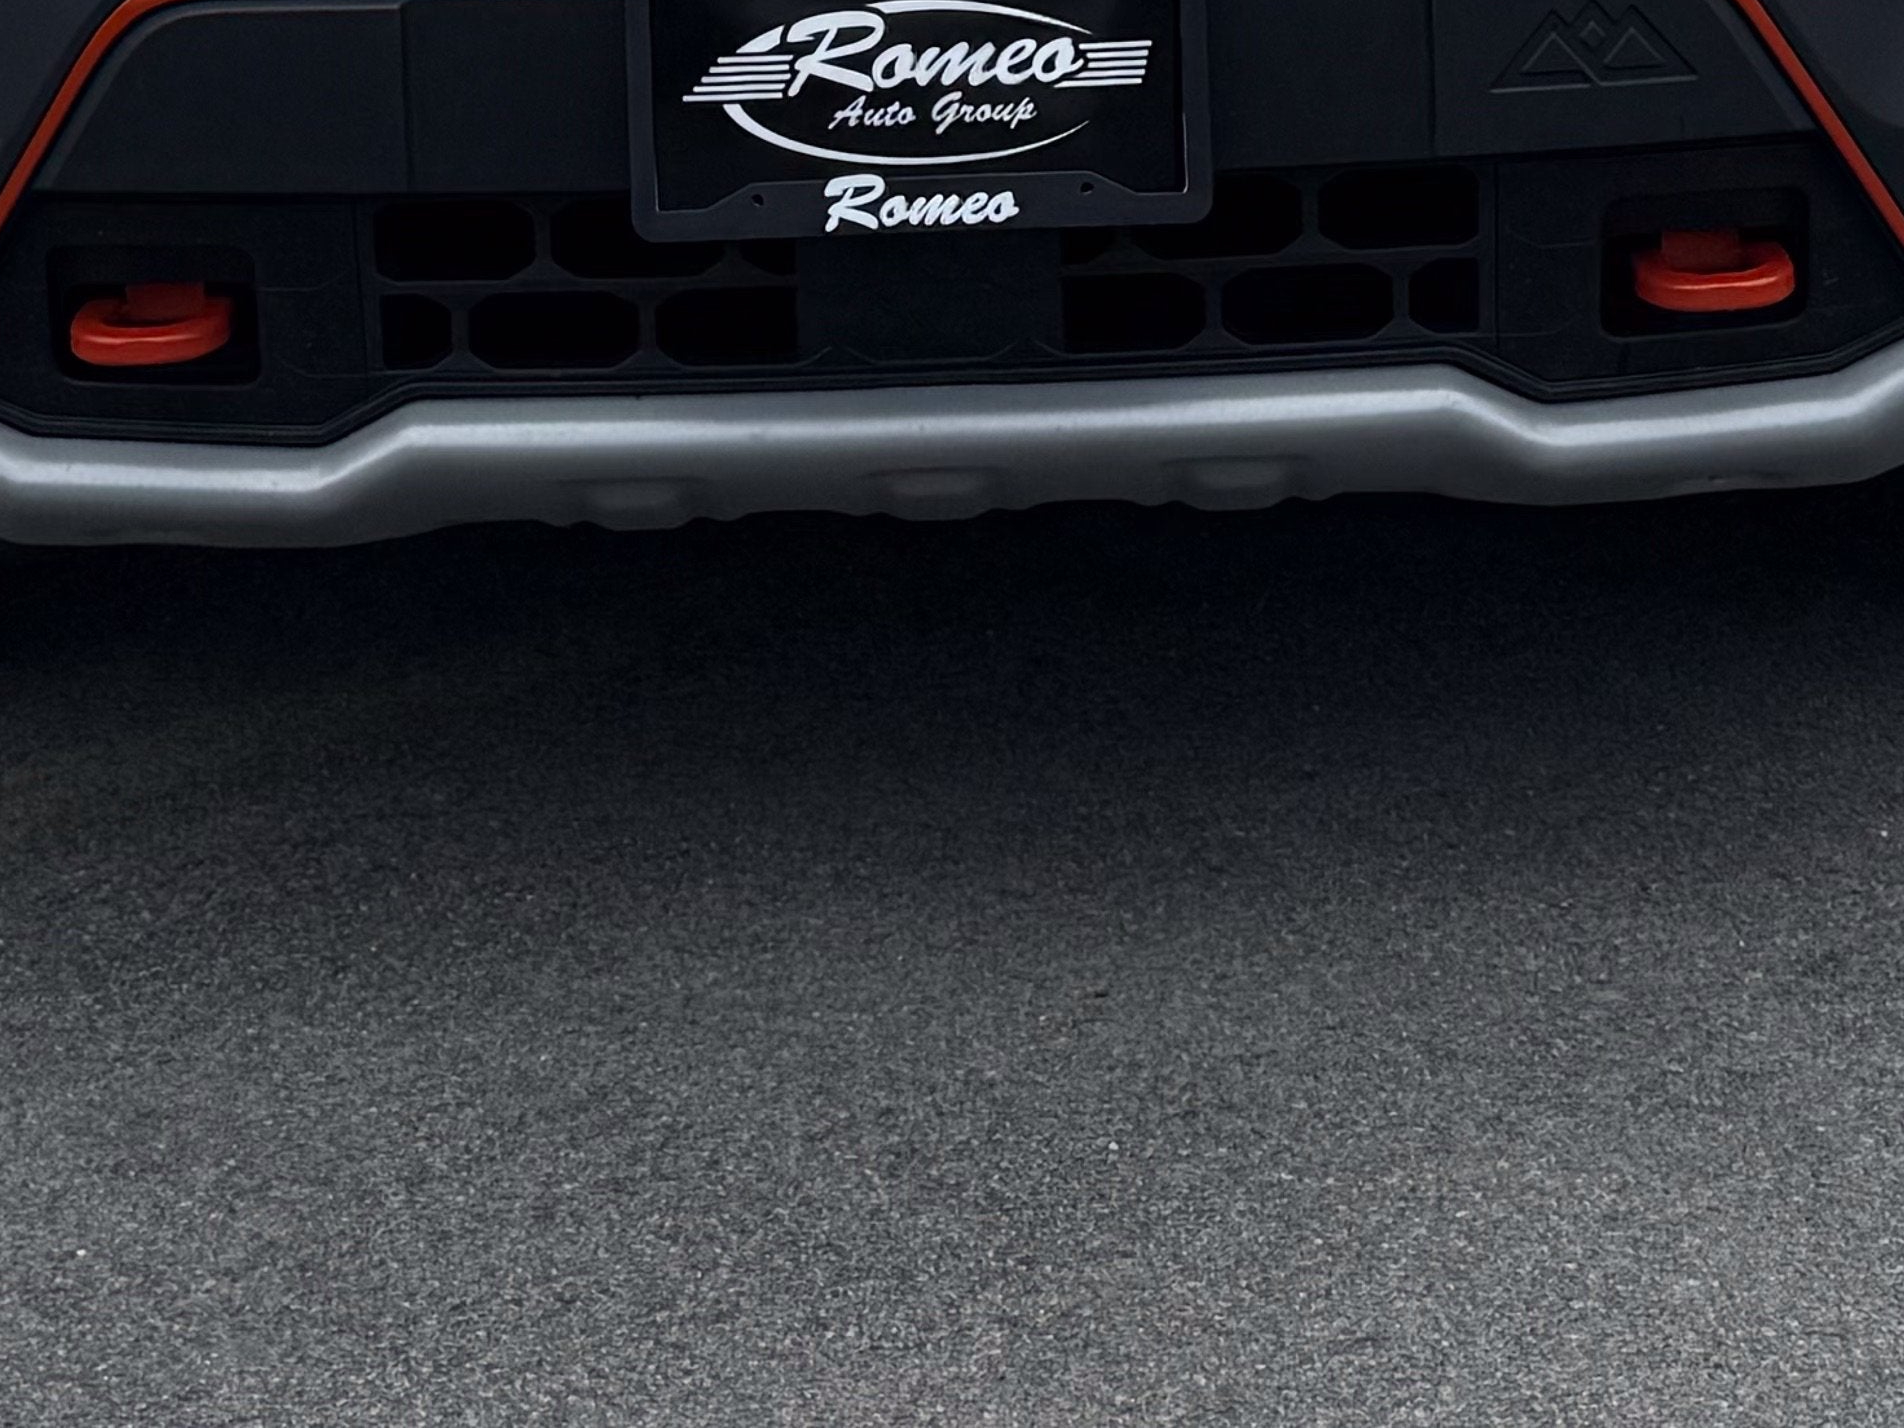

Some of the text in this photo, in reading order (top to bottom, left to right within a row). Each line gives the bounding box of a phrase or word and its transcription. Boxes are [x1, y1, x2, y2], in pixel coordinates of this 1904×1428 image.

[787, 11, 1083, 96] Romeo
[828, 91, 1037, 134] Auto Group
[824, 174, 1019, 232] Romeo
